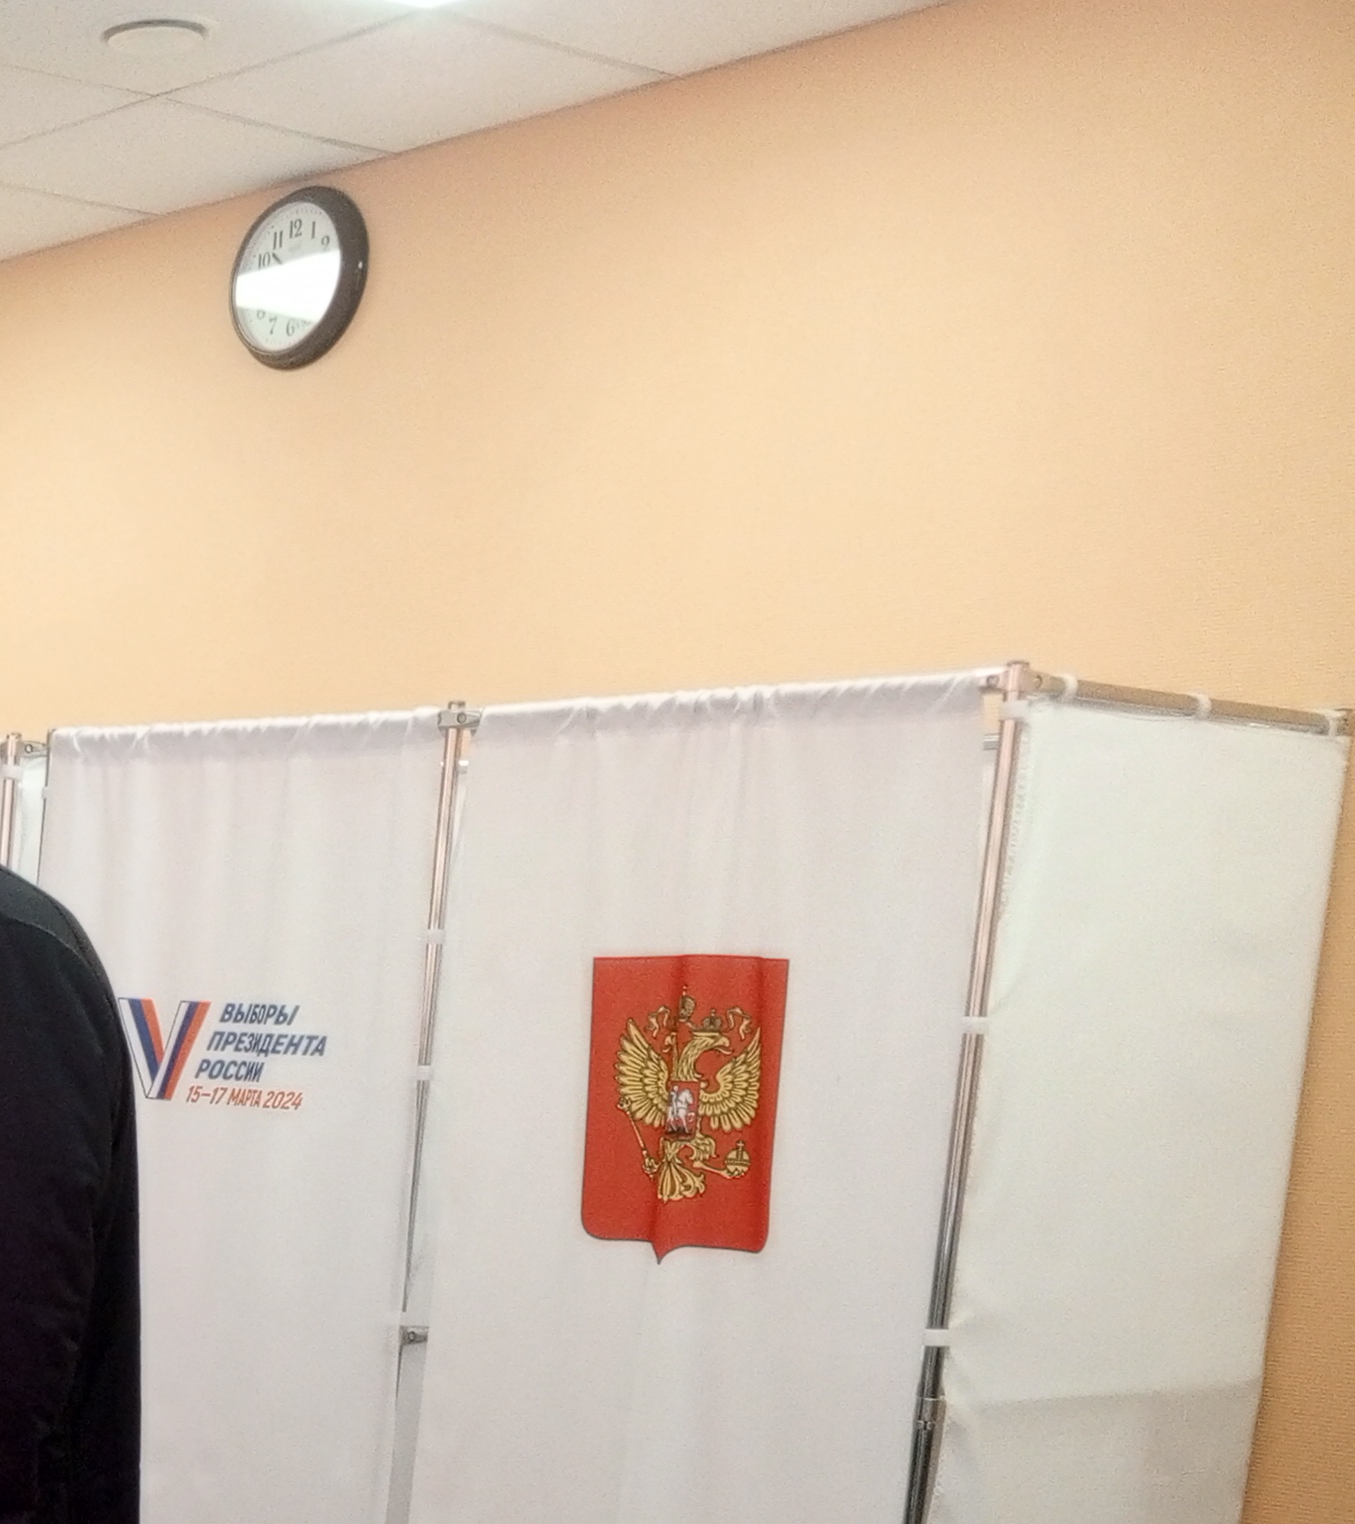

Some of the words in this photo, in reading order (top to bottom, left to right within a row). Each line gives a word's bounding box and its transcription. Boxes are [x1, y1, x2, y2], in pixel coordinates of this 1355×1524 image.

[273, 230, 284, 250] 11
[290, 218, 302, 239] 12
[257, 251, 271, 270] 10
[219, 1003, 300, 1026] ВЫБОРЫ
[206, 1031, 327, 1057] ПРЕЗИДЕНТА
[195, 1059, 265, 1083] РОССИИ
[227, 1088, 262, 1108] МАРТА
[262, 1090, 304, 1111] 2024
